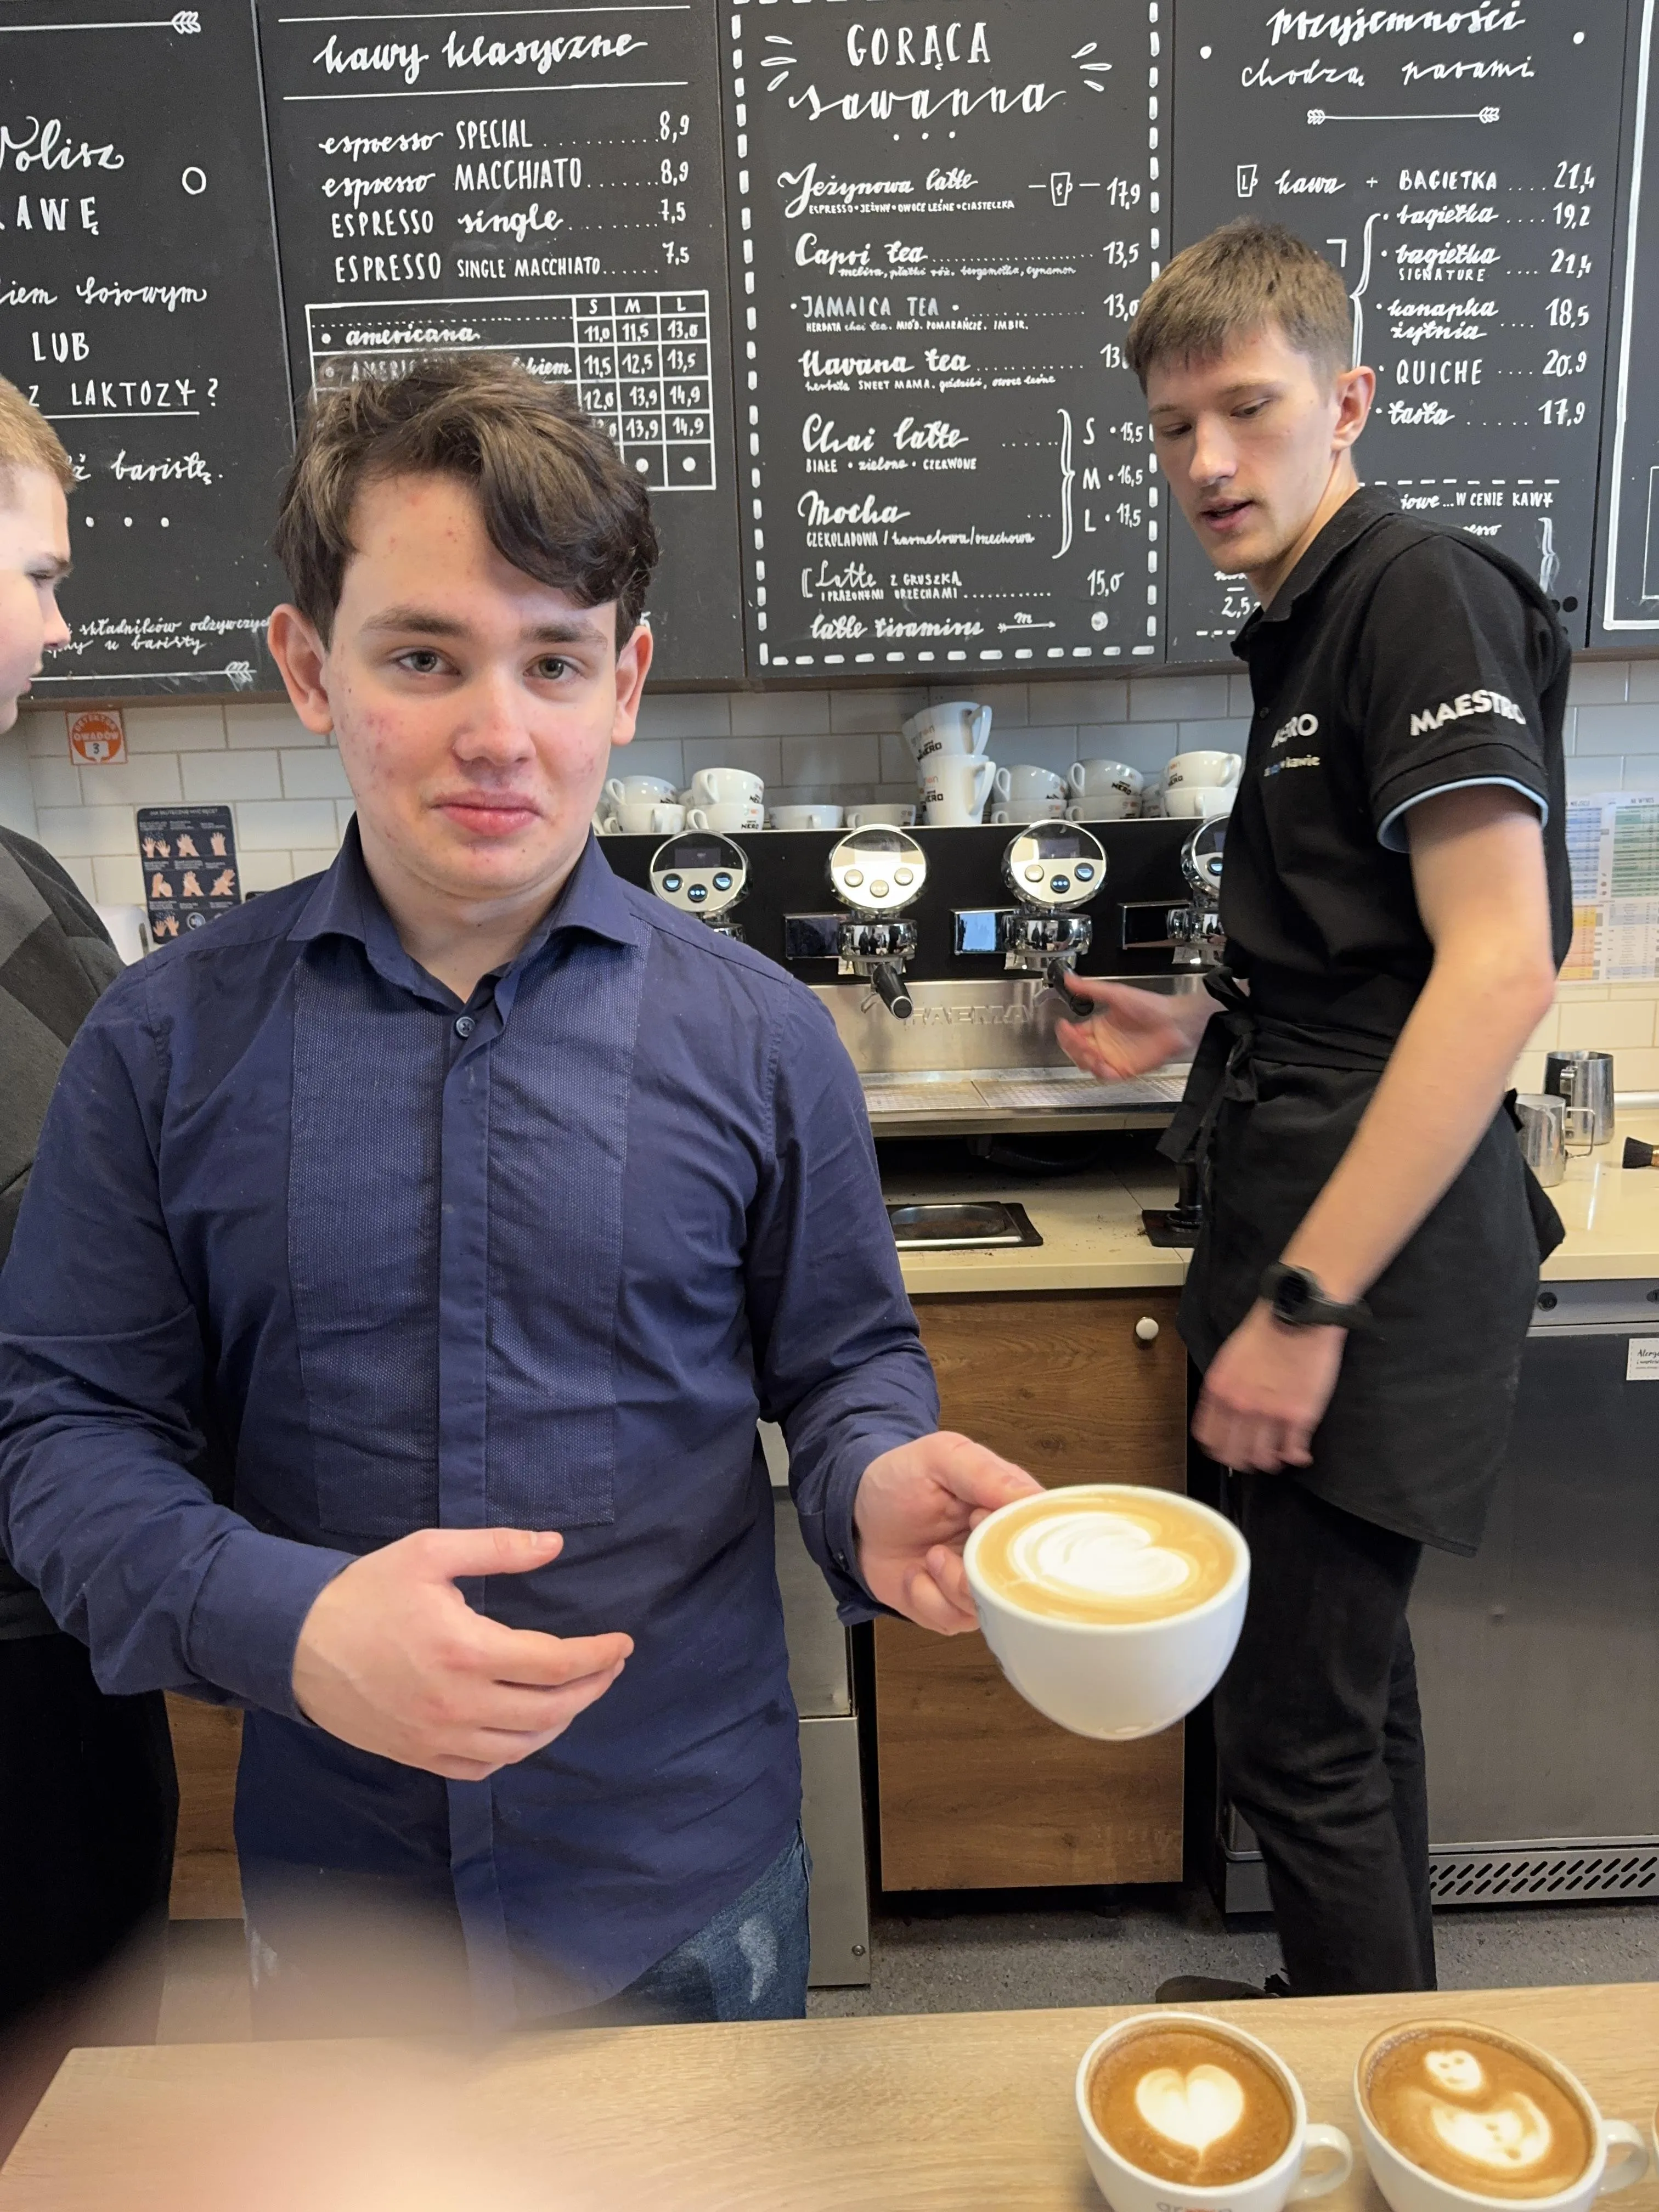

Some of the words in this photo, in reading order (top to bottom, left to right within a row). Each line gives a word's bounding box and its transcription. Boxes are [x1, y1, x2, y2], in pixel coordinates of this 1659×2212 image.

[313, 35, 430, 84] kawy
[441, 30, 648, 75] klasyczne
[847, 22, 991, 71] GORĄCA
[1242, 58, 1365, 87] chodzą
[1401, 56, 1534, 86] parami
[318, 132, 444, 162] espresso
[456, 119, 533, 150] SPECIAL
[659, 110, 690, 143] 8,9
[321, 173, 436, 210] espresso
[455, 157, 582, 191] MACCHIATO
[661, 159, 689, 186] 8,9
[777, 163, 915, 218] Jeżynowa
[1107, 177, 1141, 210] 17,9
[1399, 170, 1497, 191] BAGIETKA
[0, 195, 99, 236] AWĘ
[331, 208, 433, 238] ESPRESSO
[458, 202, 564, 244] single
[1553, 201, 1590, 229] 19,2
[335, 252, 441, 283] ESPRESSO
[457, 259, 506, 279] SINGLE
[514, 256, 600, 277] MACCHIATO
[662, 241, 690, 266] 7,5
[795, 233, 871, 275] Capri
[884, 240, 928, 263] tea
[1103, 241, 1139, 268] 13,5
[1398, 268, 1486, 281] SIGNATURE
[0, 280, 58, 306] iem
[589, 298, 597, 315] S
[624, 298, 641, 314] M
[676, 297, 686, 312] L
[800, 295, 891, 318] JAMAICA
[906, 297, 939, 317] TEA
[1545, 298, 1589, 329] 18,5
[32, 331, 89, 363] LUB
[346, 323, 481, 347] americana
[584, 325, 610, 343] 11,0
[622, 321, 650, 342] 11,5
[667, 320, 698, 340] 13,0
[584, 354, 612, 378] 11,5
[622, 353, 653, 375] 12,5
[667, 349, 696, 373] 13,5
[924, 348, 971, 372] tea
[1396, 359, 1482, 385] QUICHE
[629, 386, 658, 409] 13,9
[1538, 398, 1585, 426] 17,9
[625, 418, 658, 440] 13,9
[802, 413, 876, 453] Chai
[1083, 417, 1094, 445] S
[806, 458, 838, 473] BIAŁE
[923, 457, 977, 470] CZERWONE
[1082, 467, 1101, 490] M
[1117, 465, 1143, 487] 16,5
[797, 490, 911, 526] Mocha
[1085, 509, 1097, 532] L
[1470, 492, 1503, 506] CENIE
[1512, 492, 1554, 508] KAWY
[806, 531, 878, 548] CZEKOLADOWA
[93, 742, 100, 754] 3
